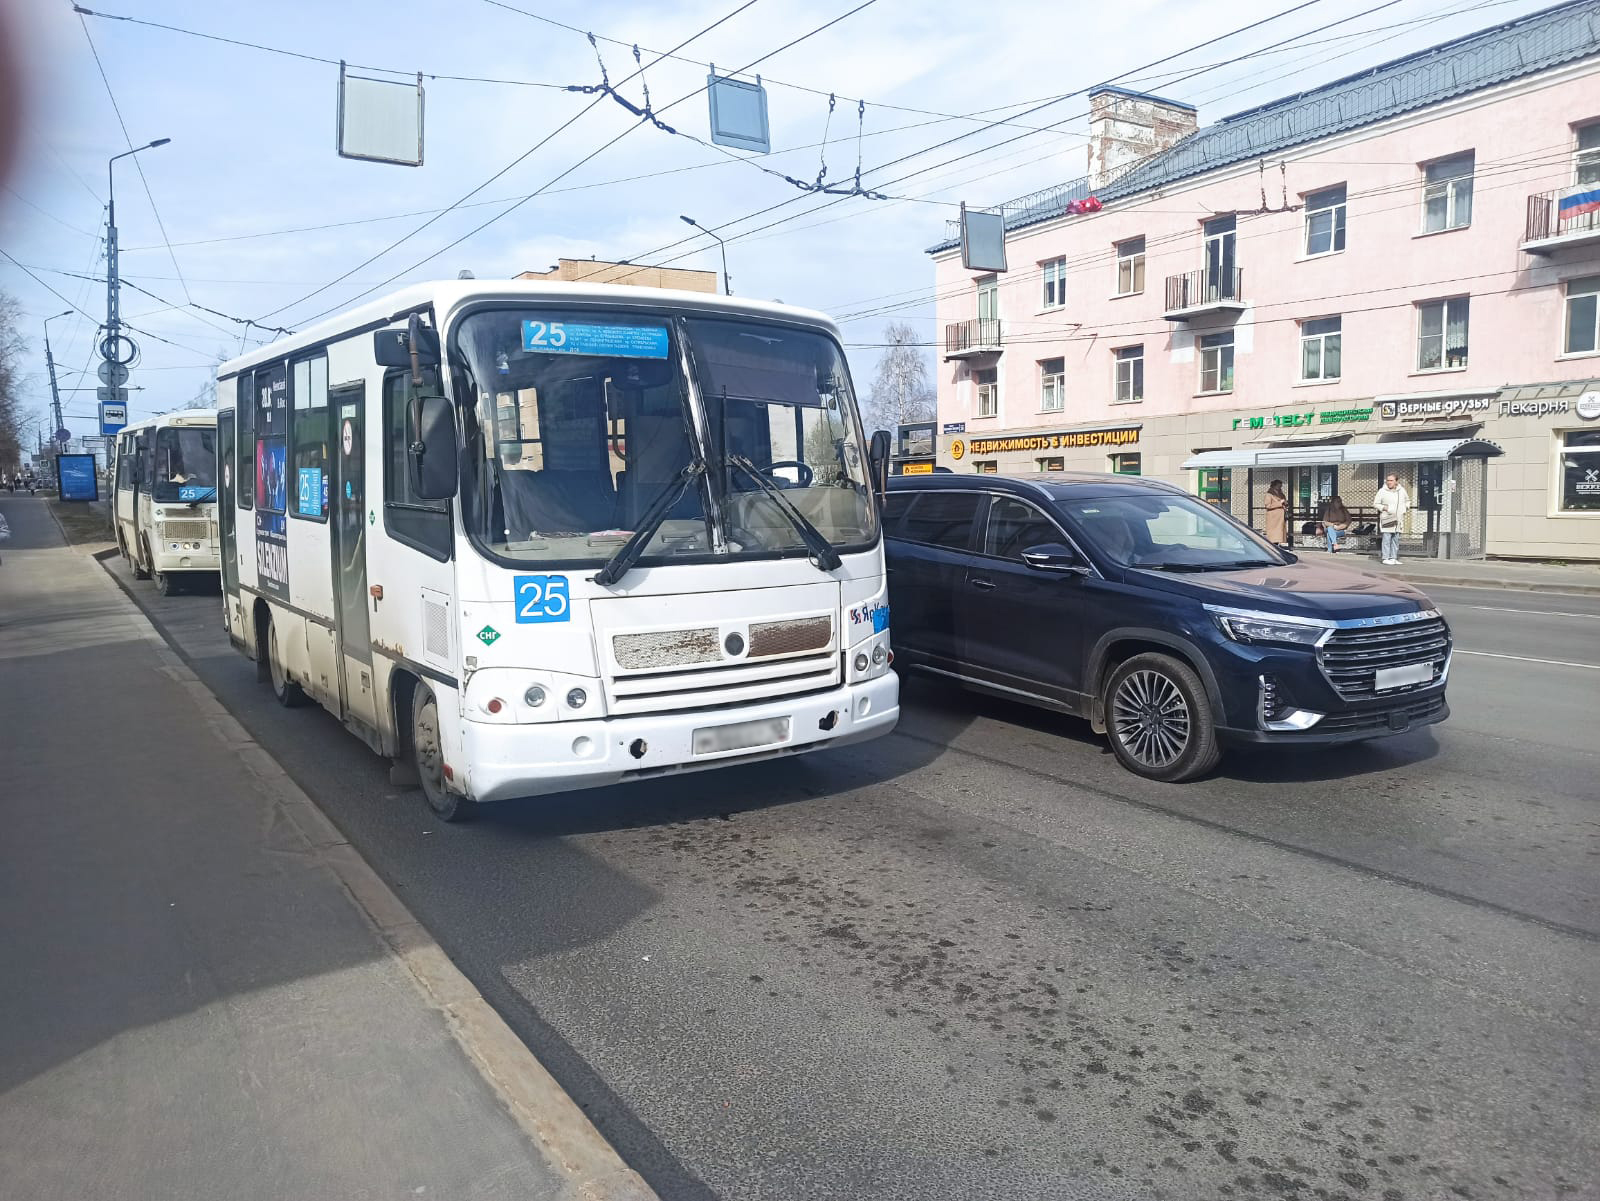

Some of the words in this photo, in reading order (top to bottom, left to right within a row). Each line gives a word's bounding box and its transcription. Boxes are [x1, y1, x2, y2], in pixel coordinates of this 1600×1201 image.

[530, 321, 566, 346] 25
[1499, 399, 1569, 417] Пекарня
[970, 437, 1049, 453] НЕДВИЖИМОСТЬ
[1062, 430, 1139, 447] ИНВЕСТИЦИИ
[181, 489, 196, 499] 25
[300, 473, 310, 501] 25
[520, 582, 567, 617] 25
[480, 631, 497, 640] СНГ
